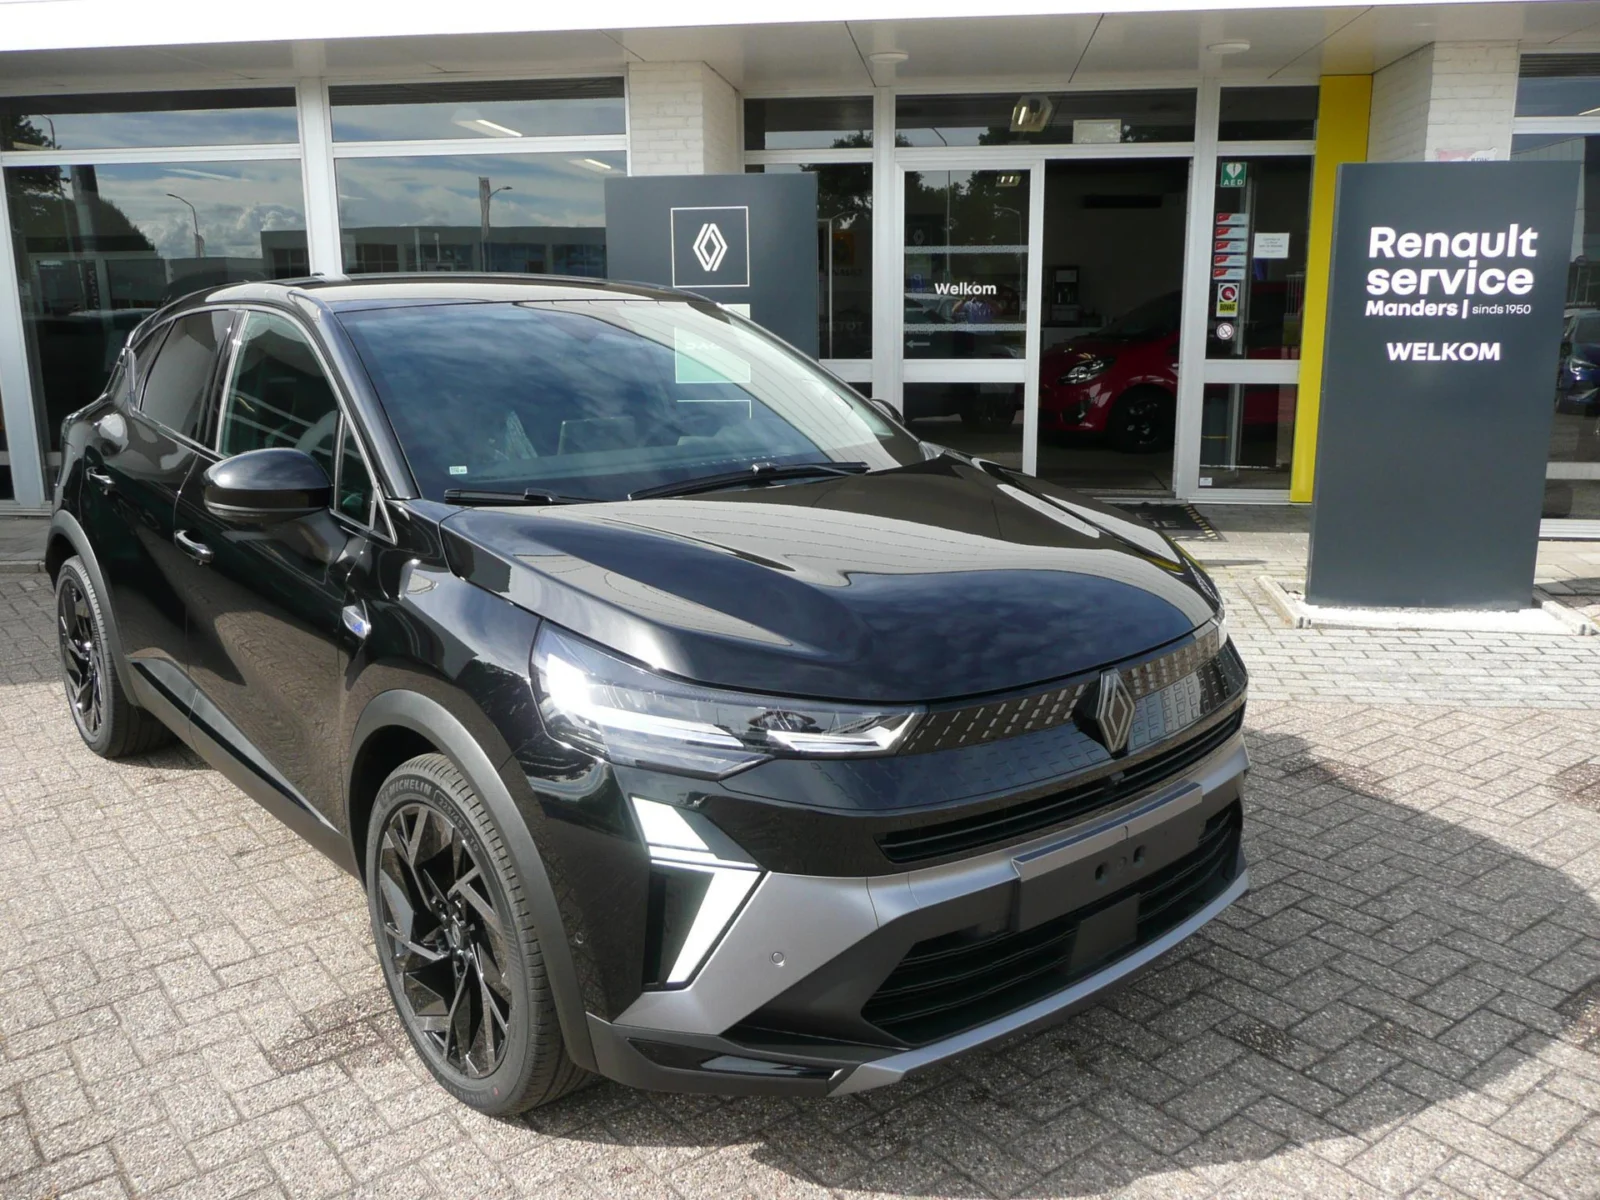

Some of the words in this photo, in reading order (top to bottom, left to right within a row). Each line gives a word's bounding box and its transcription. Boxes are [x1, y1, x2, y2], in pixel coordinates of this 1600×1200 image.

[1368, 224, 1539, 259] Renault
[1366, 260, 1534, 296] service
[934, 282, 997, 295] Welkom
[1365, 300, 1459, 317] Manders
[1472, 303, 1504, 315] sinds
[1505, 304, 1532, 315] 1950
[1386, 342, 1502, 361] WELKOM
[389, 779, 432, 795] MICHELIN
